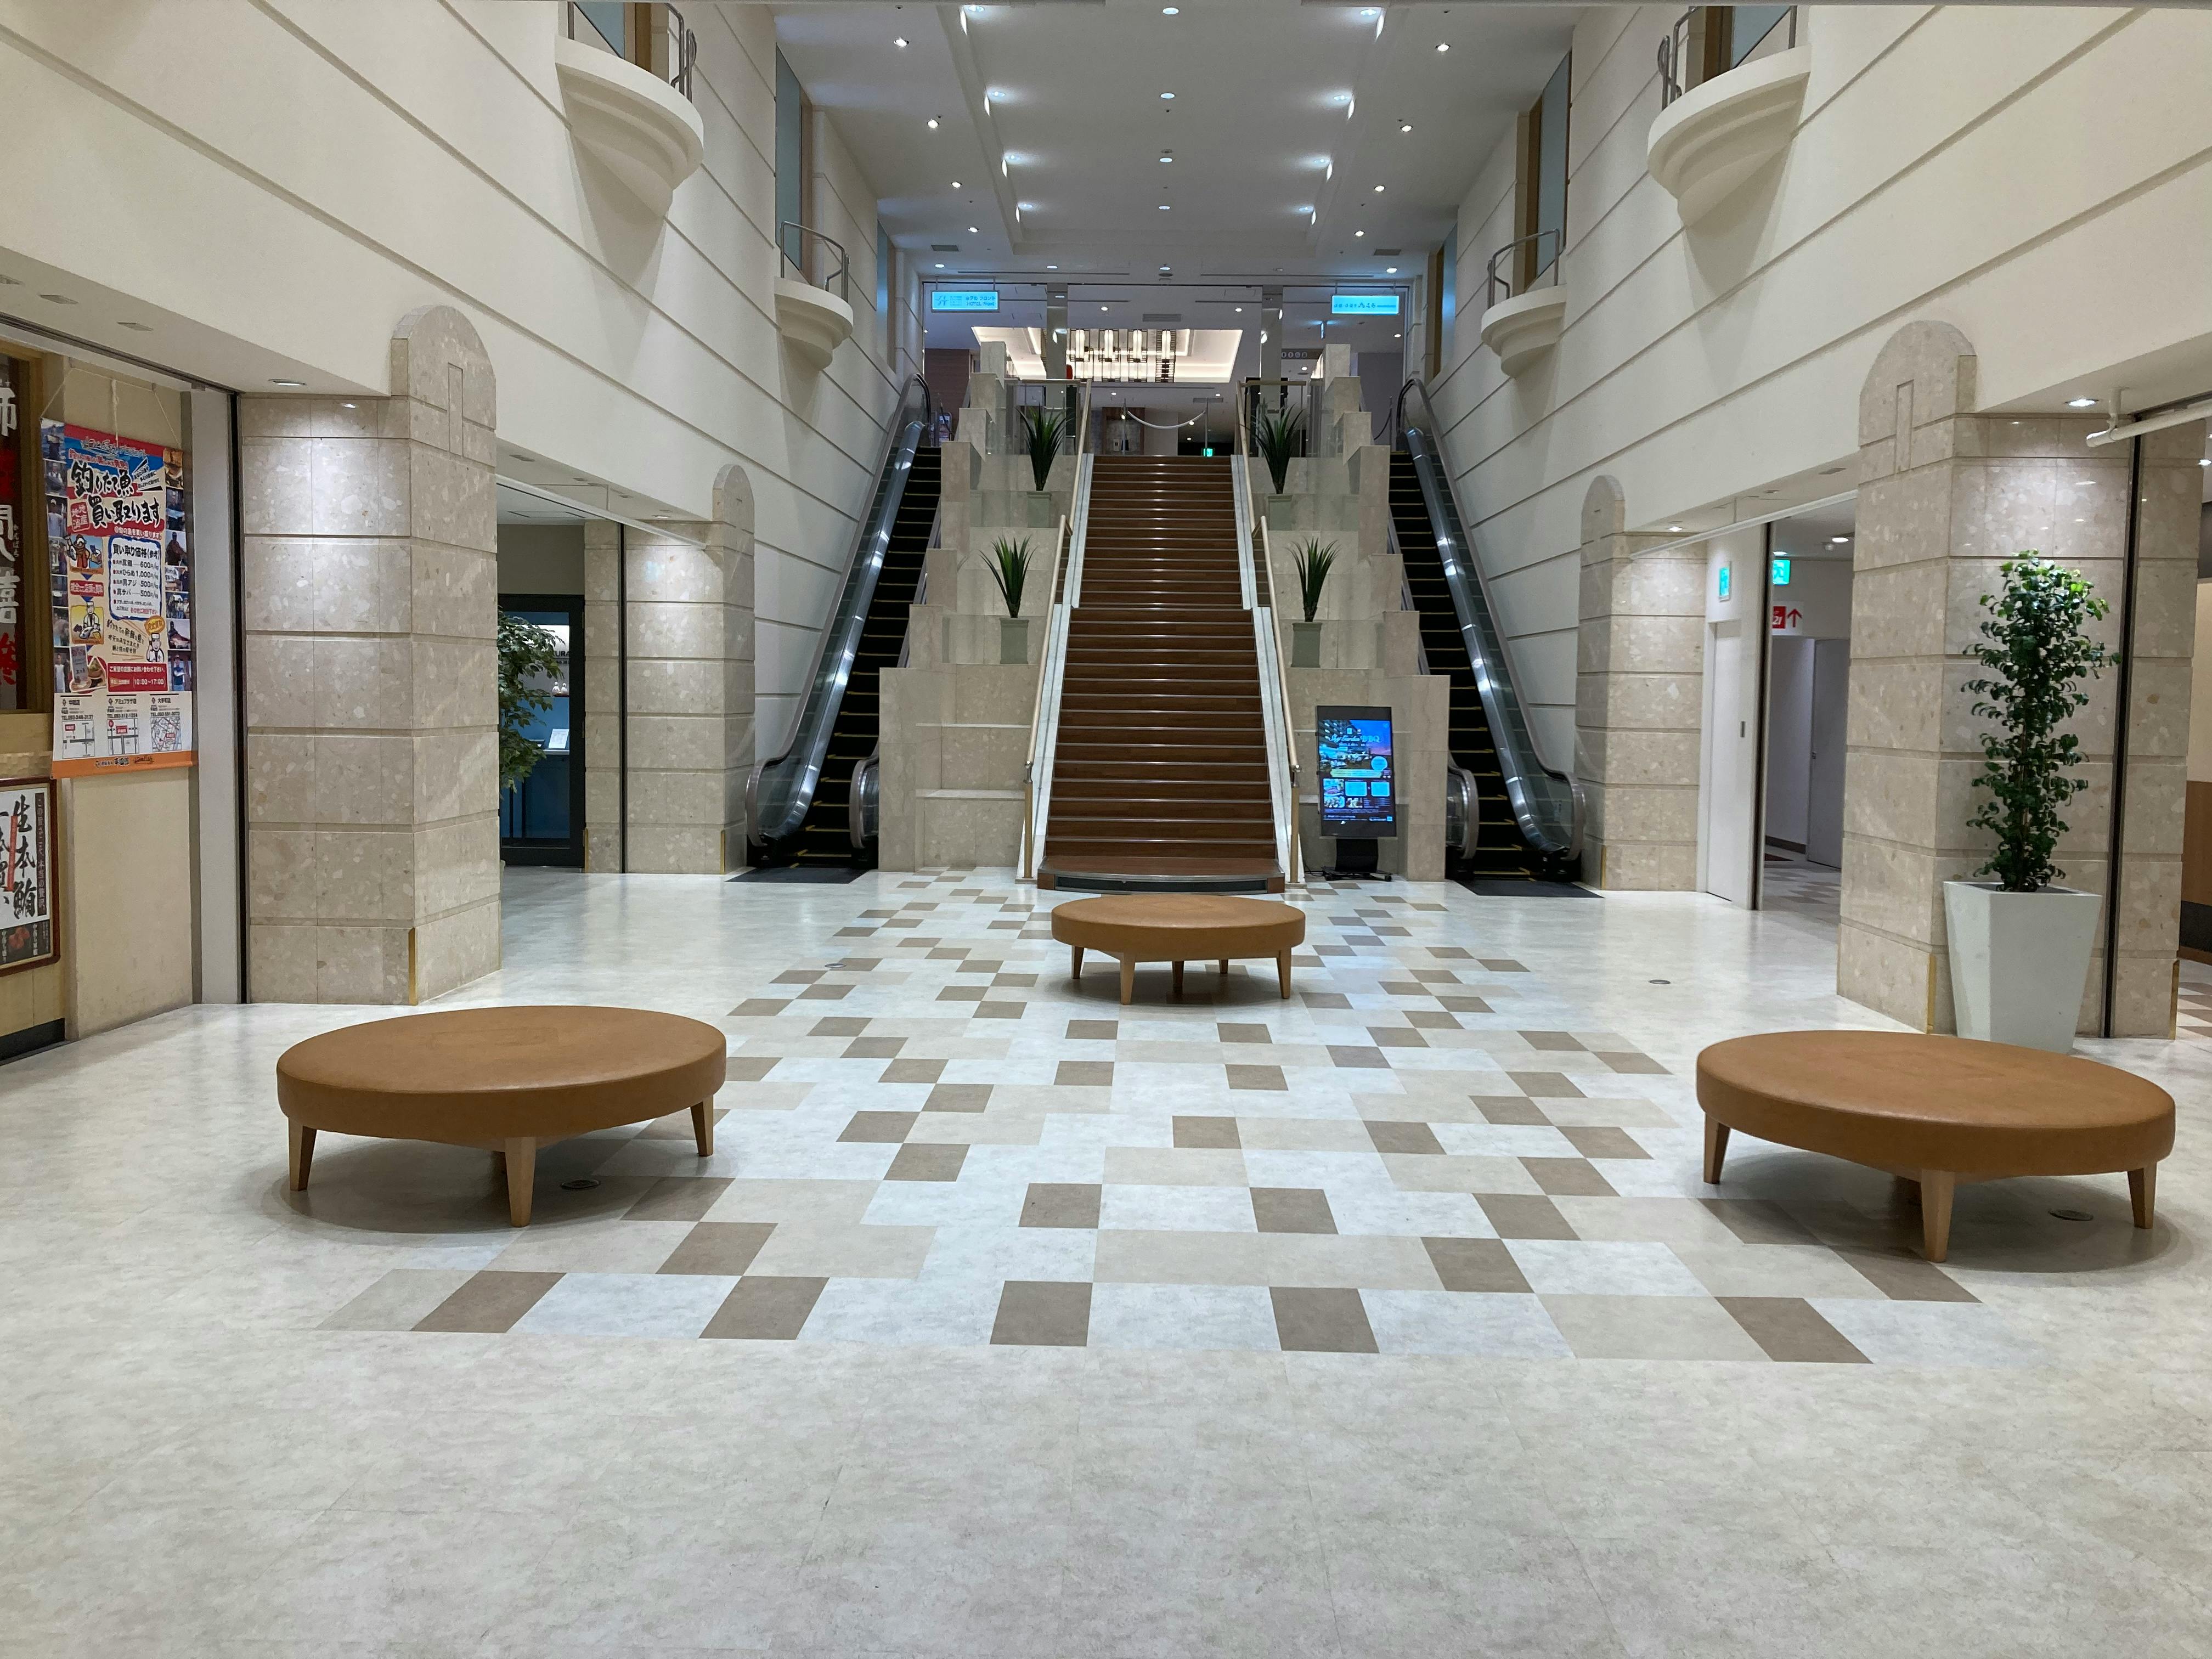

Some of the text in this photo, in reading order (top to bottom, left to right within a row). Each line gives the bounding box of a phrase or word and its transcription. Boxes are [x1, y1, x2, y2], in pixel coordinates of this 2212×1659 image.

[88, 494, 160, 528] 買い取ります
